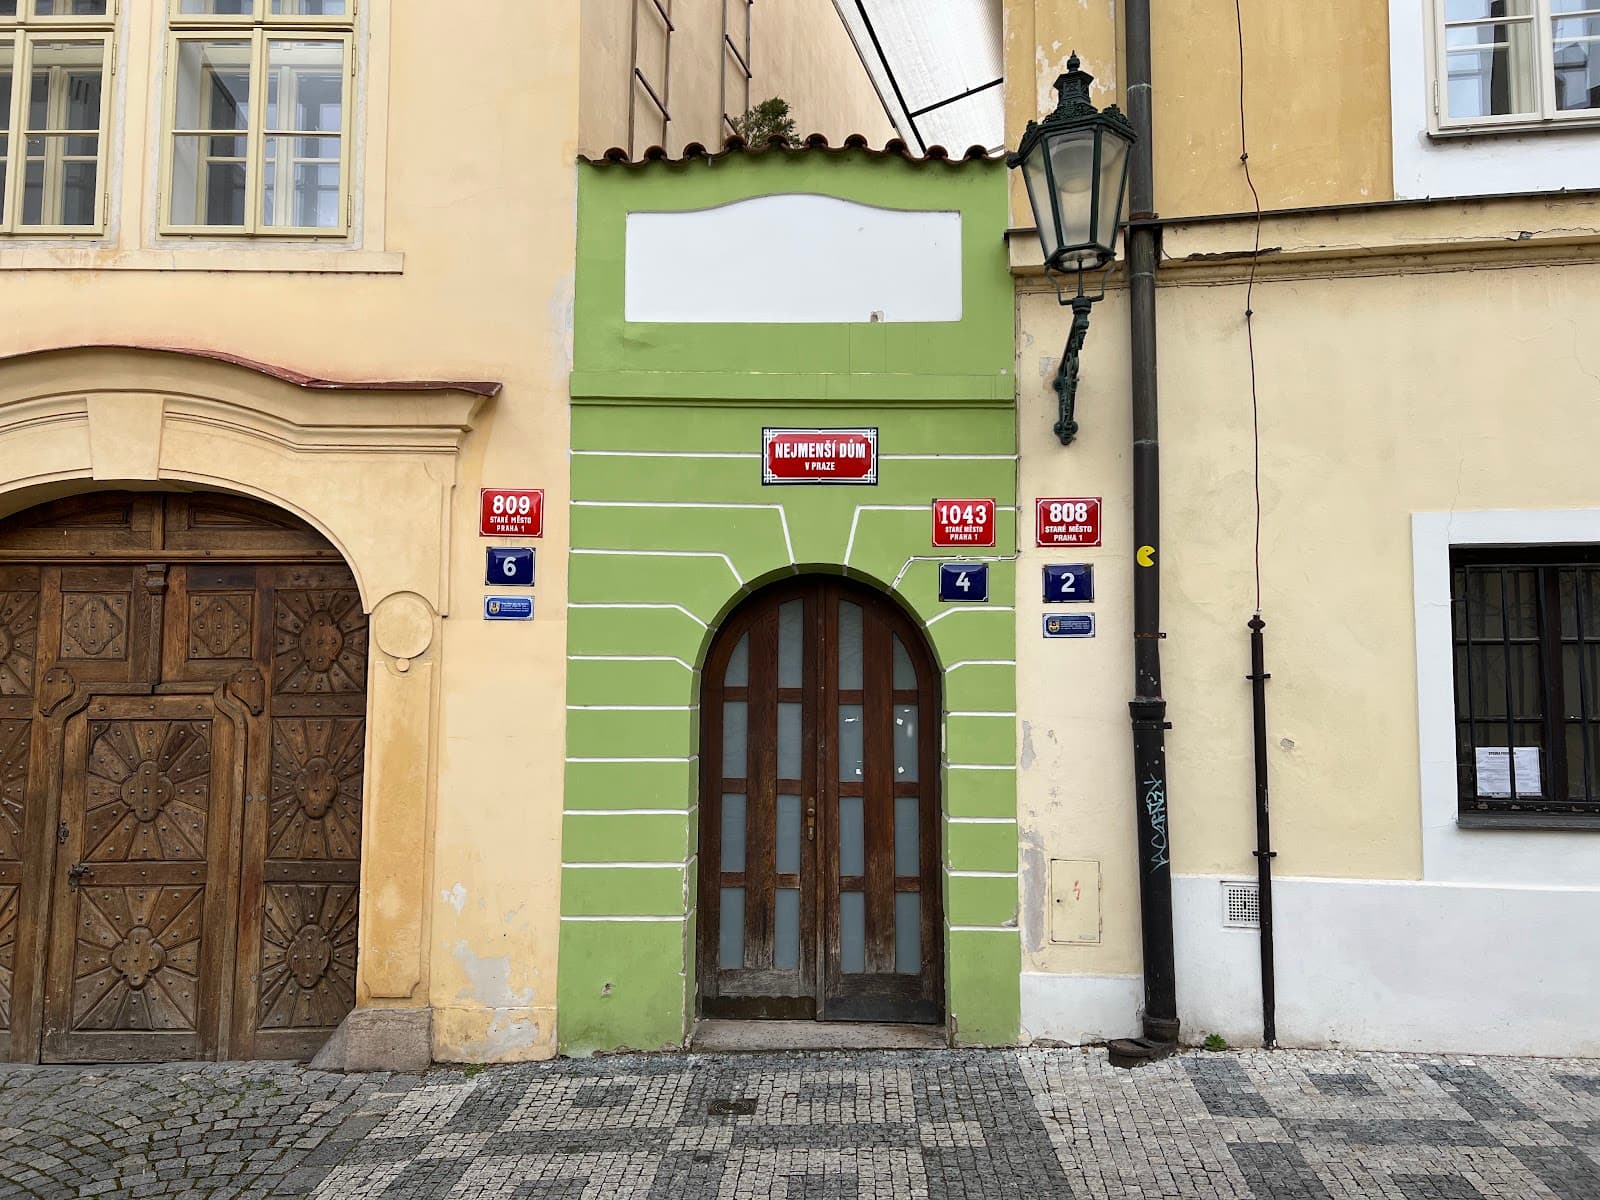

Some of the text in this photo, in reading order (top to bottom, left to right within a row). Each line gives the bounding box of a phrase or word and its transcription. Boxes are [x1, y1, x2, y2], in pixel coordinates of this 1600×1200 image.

[775, 438, 866, 458] NEJMENŠÍ DŮM
[805, 461, 836, 471] V PRAZE
[493, 495, 530, 514] 809
[490, 515, 531, 524] STARÉ MĚSTO
[940, 504, 987, 525] 1043
[1049, 502, 1088, 523] 808
[521, 525, 525, 533] 1
[945, 525, 984, 533] STARÉ MĚSTO
[1044, 523, 1093, 533] STARÉ MĚSTO
[949, 533, 979, 541] PRAHA 1
[1053, 534, 1083, 542] PRAHA 1
[503, 557, 516, 576] 6
[955, 572, 971, 592] 4
[1060, 572, 1076, 593] 2
